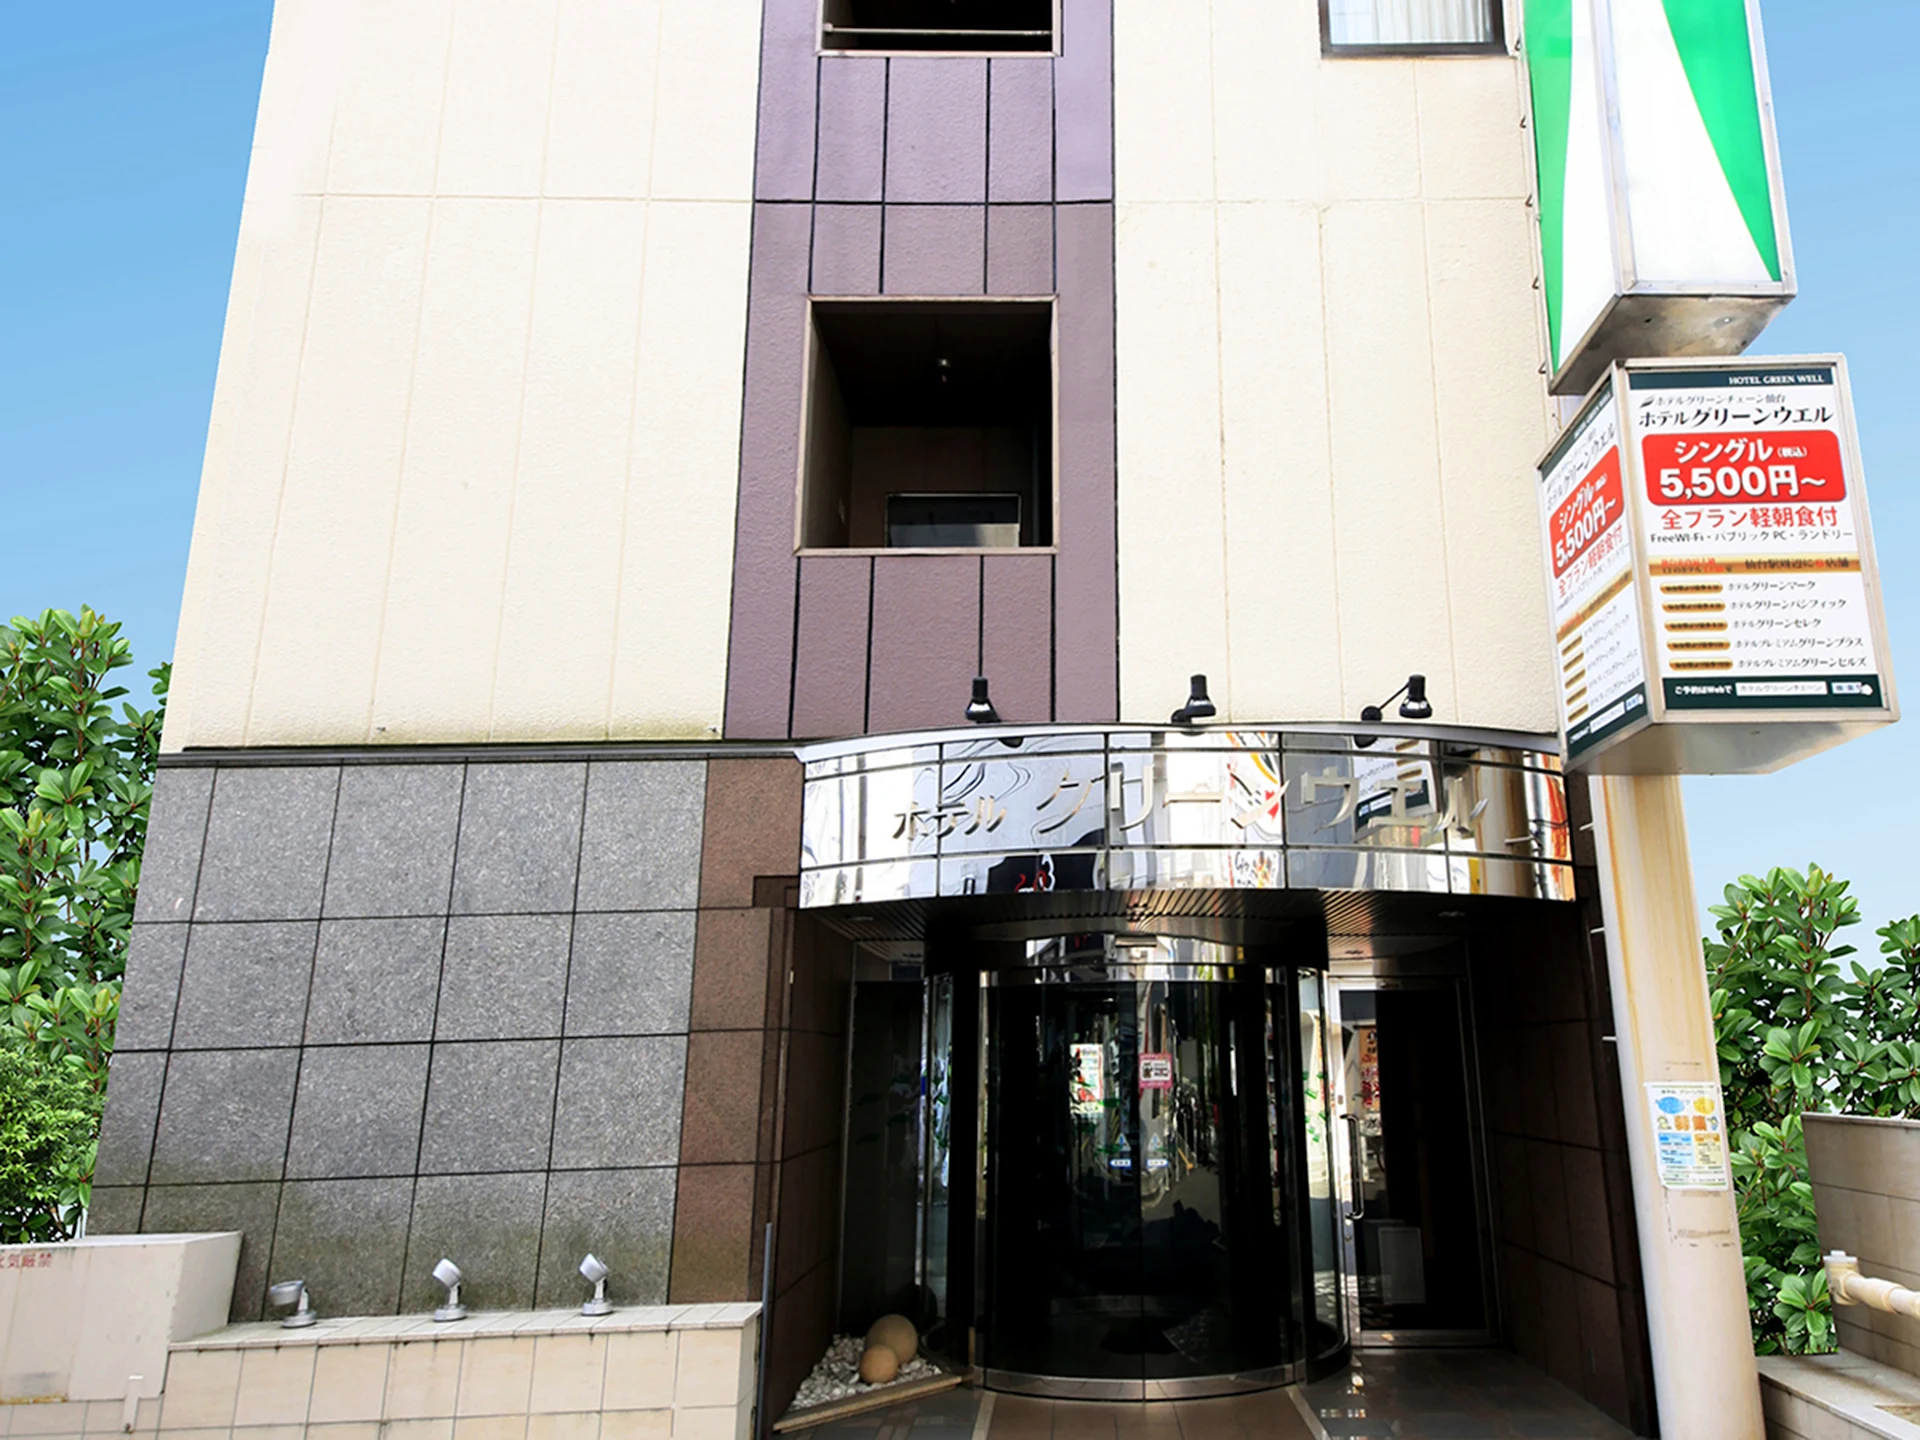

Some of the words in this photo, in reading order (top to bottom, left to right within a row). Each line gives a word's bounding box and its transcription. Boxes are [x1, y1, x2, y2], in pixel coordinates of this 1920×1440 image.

[1728, 376, 1761, 385] HOTEL
[1763, 375, 1795, 384] GREEN
[1797, 374, 1824, 383] WELL
[1639, 405, 1835, 428] ホテルグリーンウエル
[1675, 438, 1773, 464] シングル
[1661, 506, 1838, 530] 全プラン軽朝食付
[891, 795, 1007, 841] ホテル
